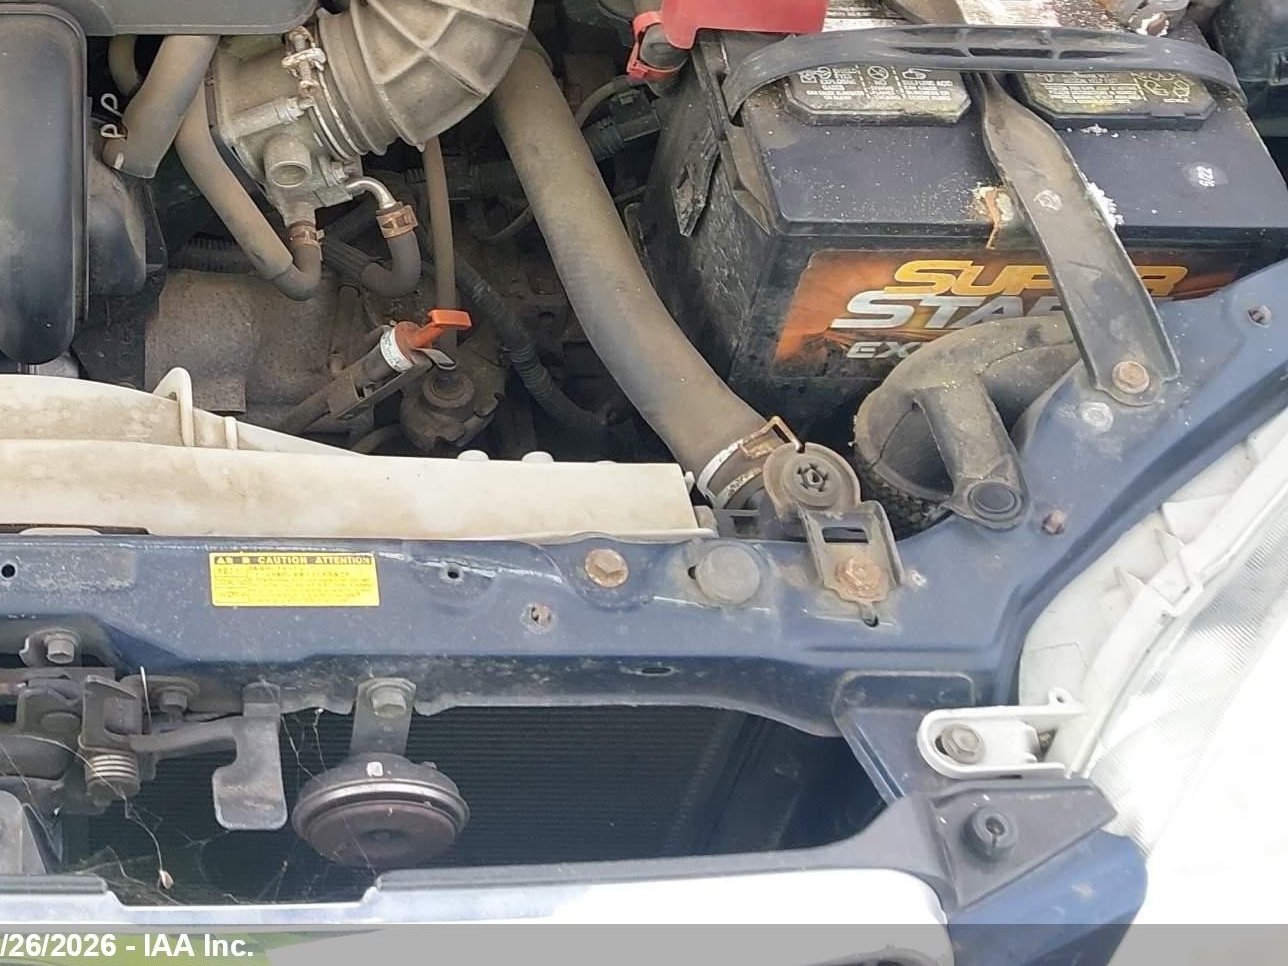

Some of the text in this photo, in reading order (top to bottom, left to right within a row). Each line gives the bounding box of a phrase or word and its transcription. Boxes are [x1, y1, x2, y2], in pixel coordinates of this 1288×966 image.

[883, 259, 1188, 297] SUPR
[257, 555, 308, 565] CAUTION
[314, 555, 372, 565] ATTENTION
